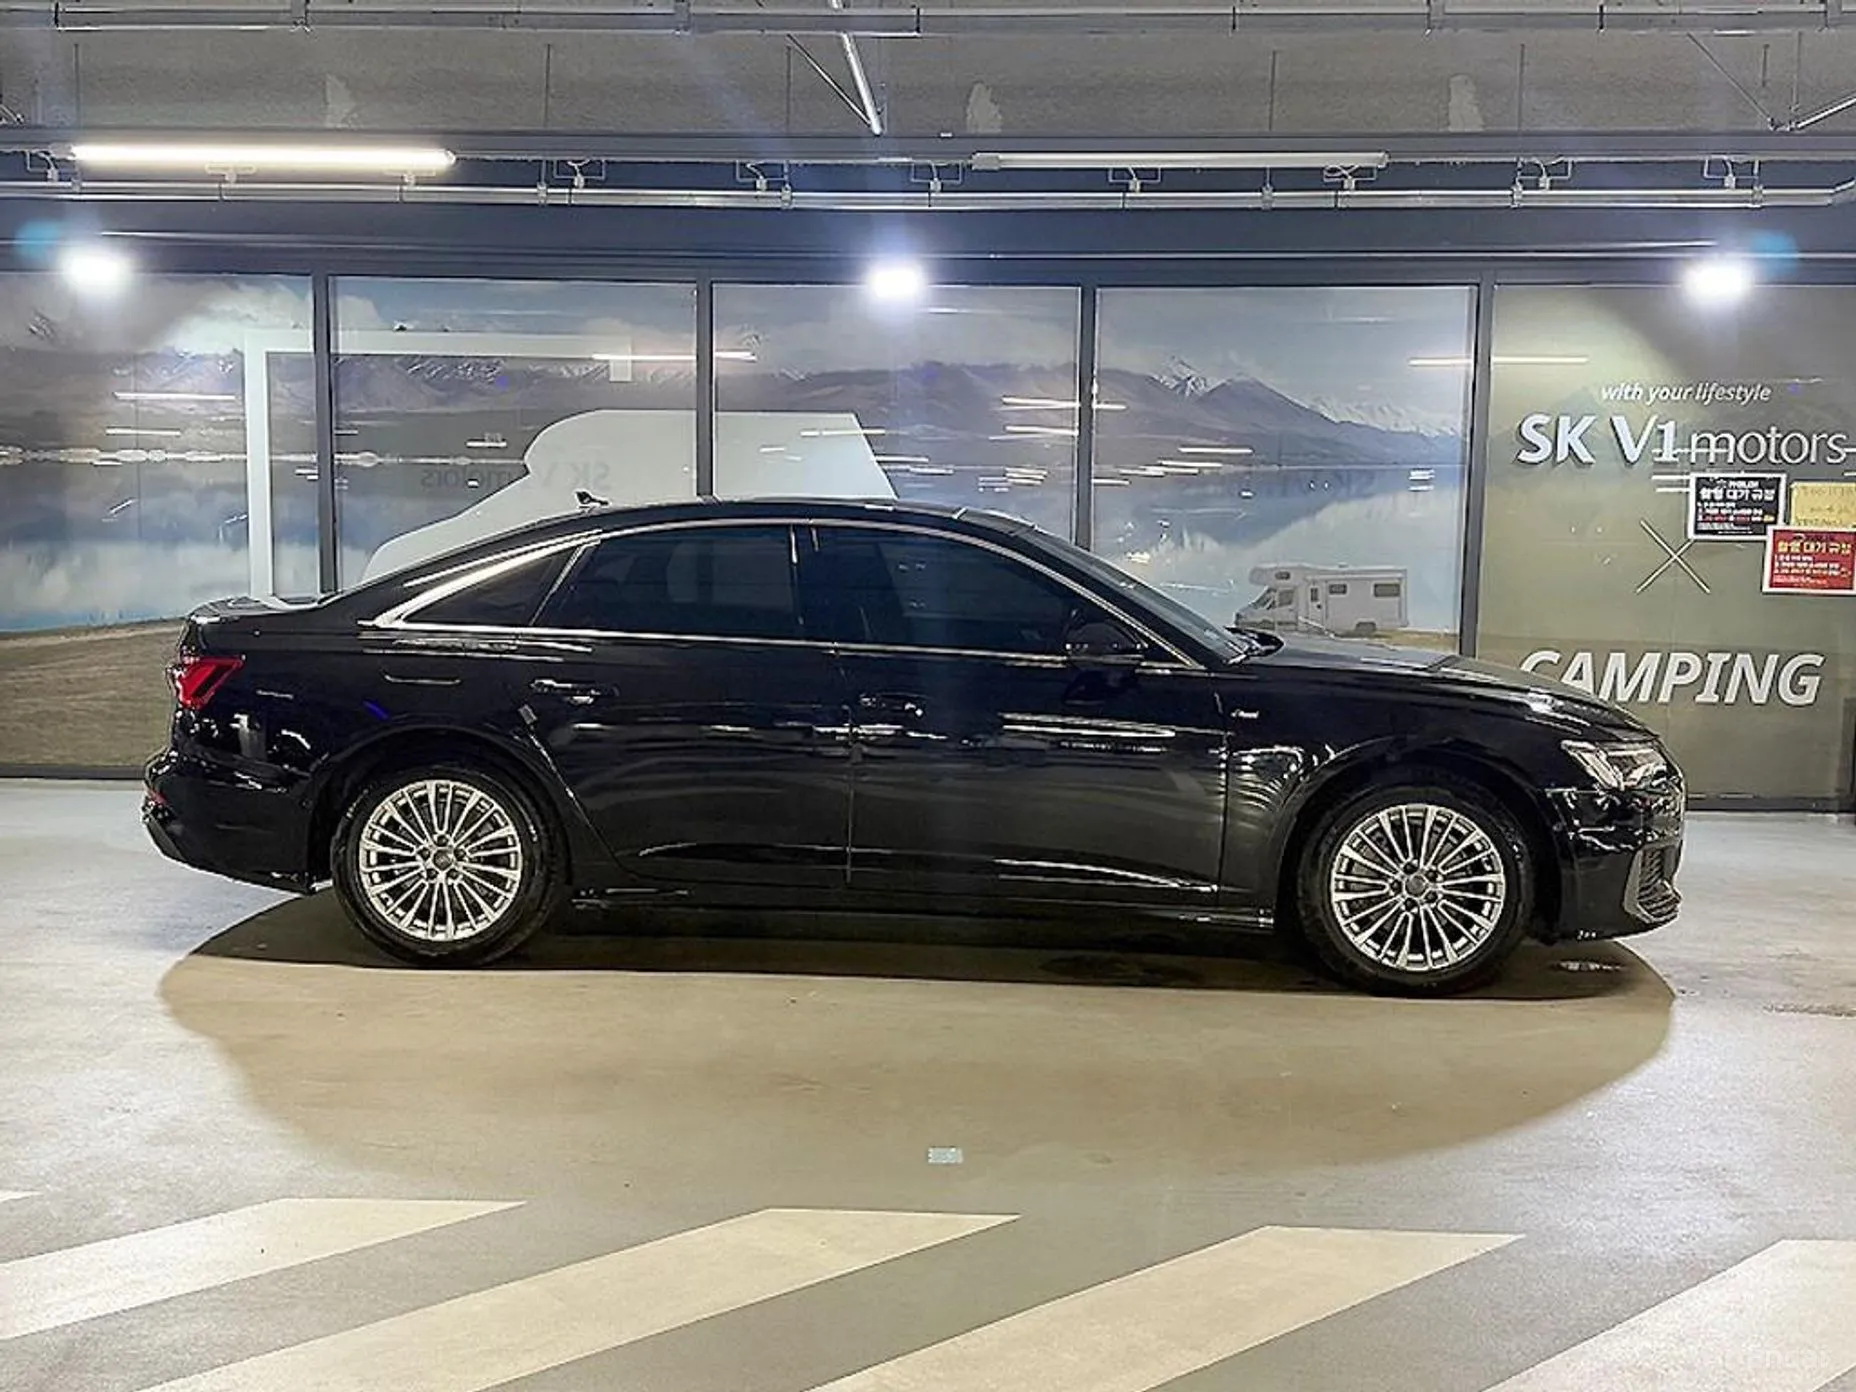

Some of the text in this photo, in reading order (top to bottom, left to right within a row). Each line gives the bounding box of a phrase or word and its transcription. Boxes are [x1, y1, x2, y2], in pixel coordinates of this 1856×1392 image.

[1601, 382, 1772, 406] with your lifestyle
[1516, 413, 1848, 464] SK V1 motors
